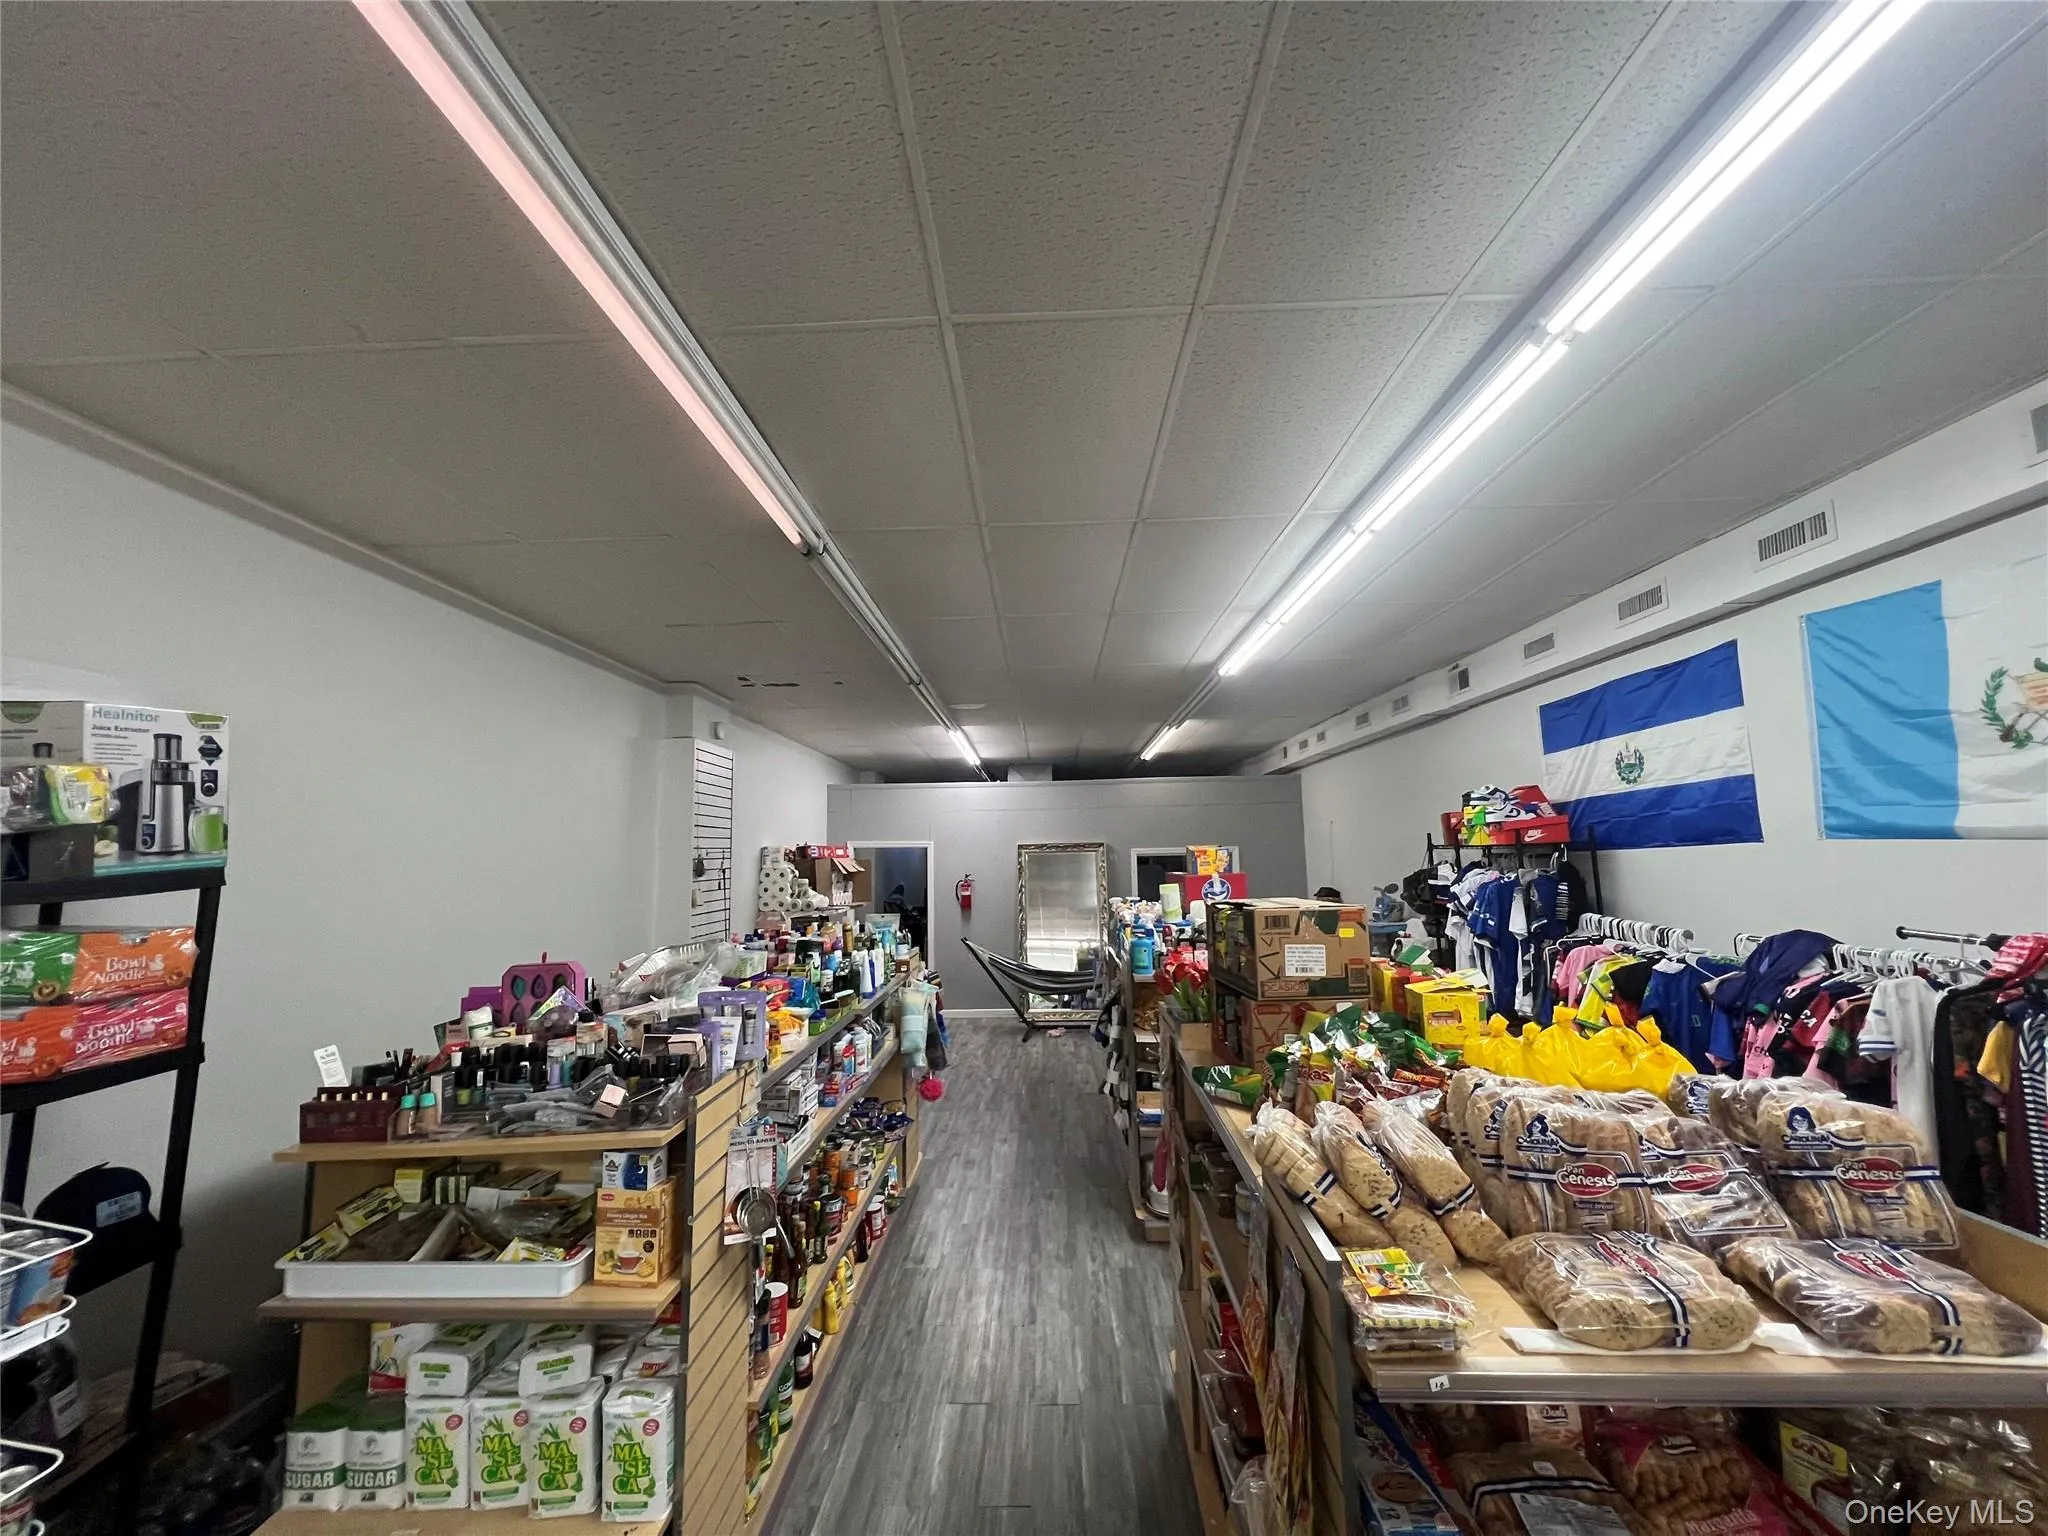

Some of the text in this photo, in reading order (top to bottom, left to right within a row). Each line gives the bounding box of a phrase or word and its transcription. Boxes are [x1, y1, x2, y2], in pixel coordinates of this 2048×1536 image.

[105, 956, 147, 972] Bowl
[93, 969, 145, 985] Noodle
[87, 1020, 136, 1040] Bowl
[1566, 1165, 1585, 1175] Pan
[1845, 1161, 1867, 1170] Pan
[1557, 1172, 1617, 1188] Genesis
[1837, 1168, 1904, 1181] Genesis
[285, 1471, 335, 1489] SUGAR
[346, 1470, 398, 1488] SUGAR
